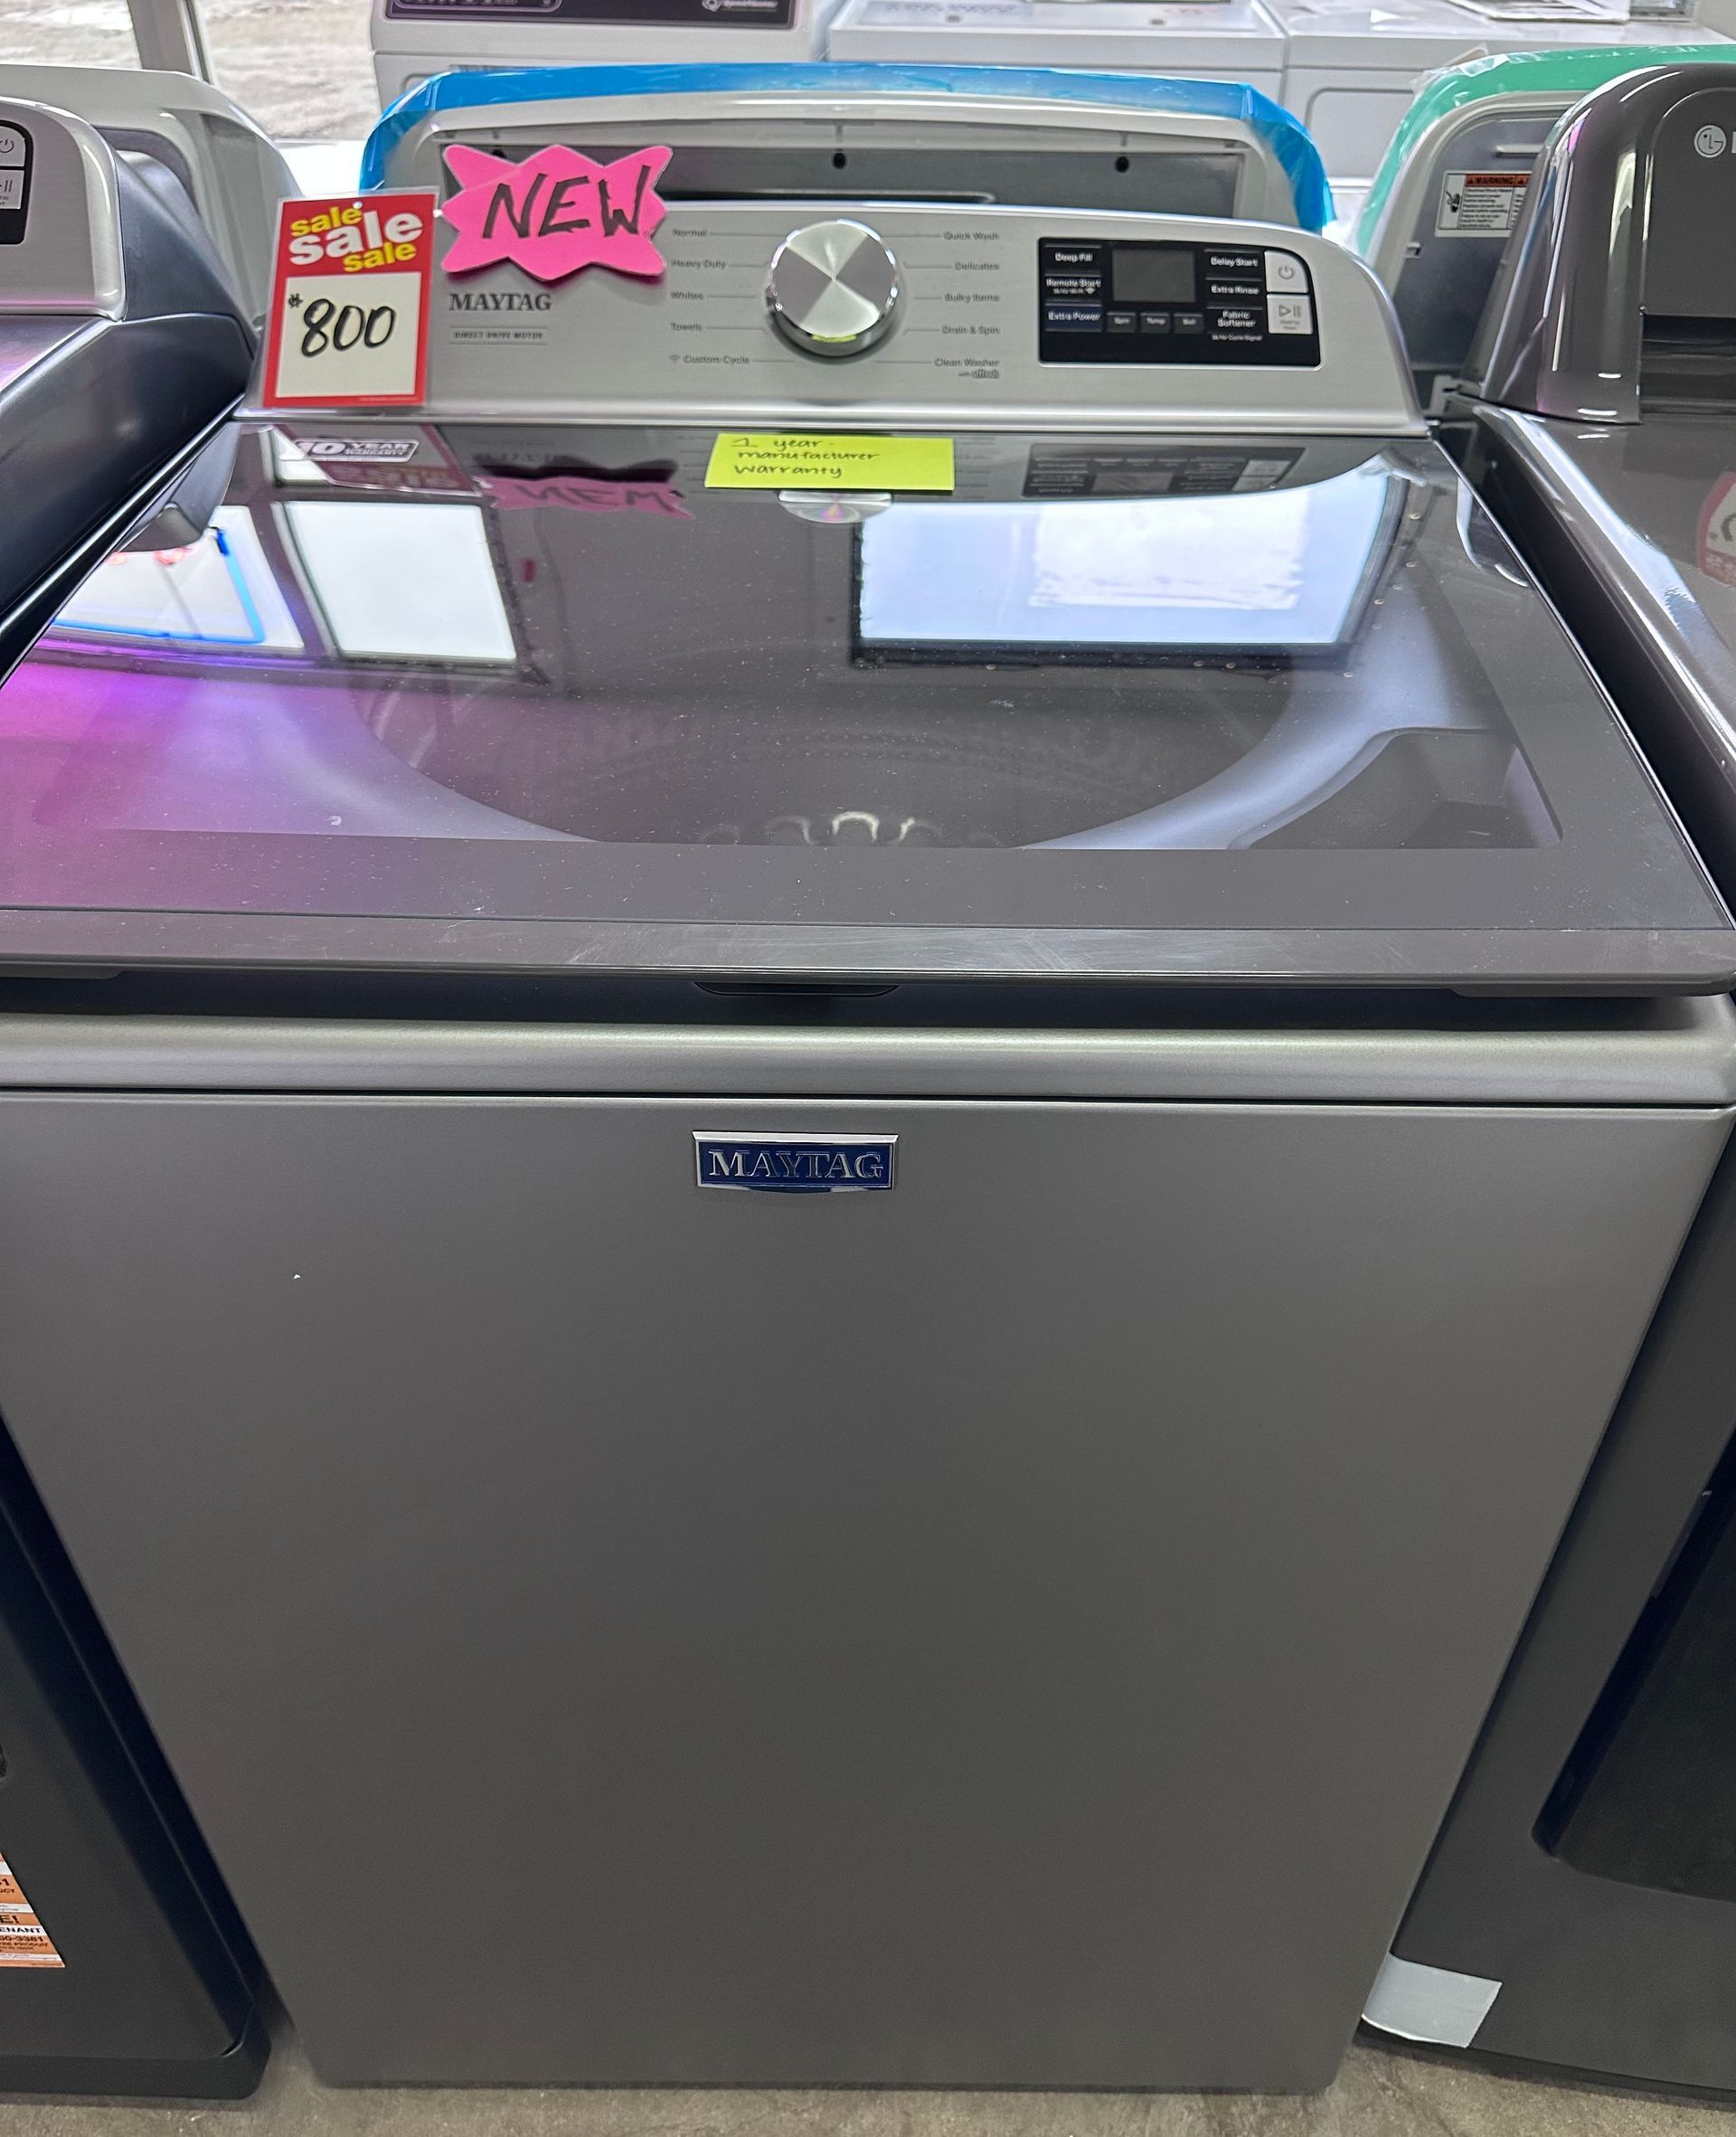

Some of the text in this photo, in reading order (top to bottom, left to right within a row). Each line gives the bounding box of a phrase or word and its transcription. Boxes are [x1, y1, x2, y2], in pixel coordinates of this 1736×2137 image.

[483, 165, 651, 239] NEW
[290, 206, 363, 237] sale
[672, 228, 707, 237] Normal
[288, 211, 422, 265] sale
[343, 241, 417, 272] sale
[1055, 252, 1079, 262] Deep
[671, 260, 728, 270] Heavy Duty
[1211, 257, 1259, 267] Delay Start
[1046, 278, 1101, 288] Remote Start
[1211, 284, 1260, 294] Extra Rinse
[448, 293, 552, 312] MAYTAG
[1048, 311, 1100, 321] Extra Power
[1222, 310, 1250, 319] Fabric
[722, 355, 750, 366] Cycle
[731, 437, 759, 448] 1
[774, 440, 822, 451] year
[738, 452, 880, 460] manufacturer
[733, 464, 843, 478] warranty
[708, 1149, 884, 1179] MAYTAG
